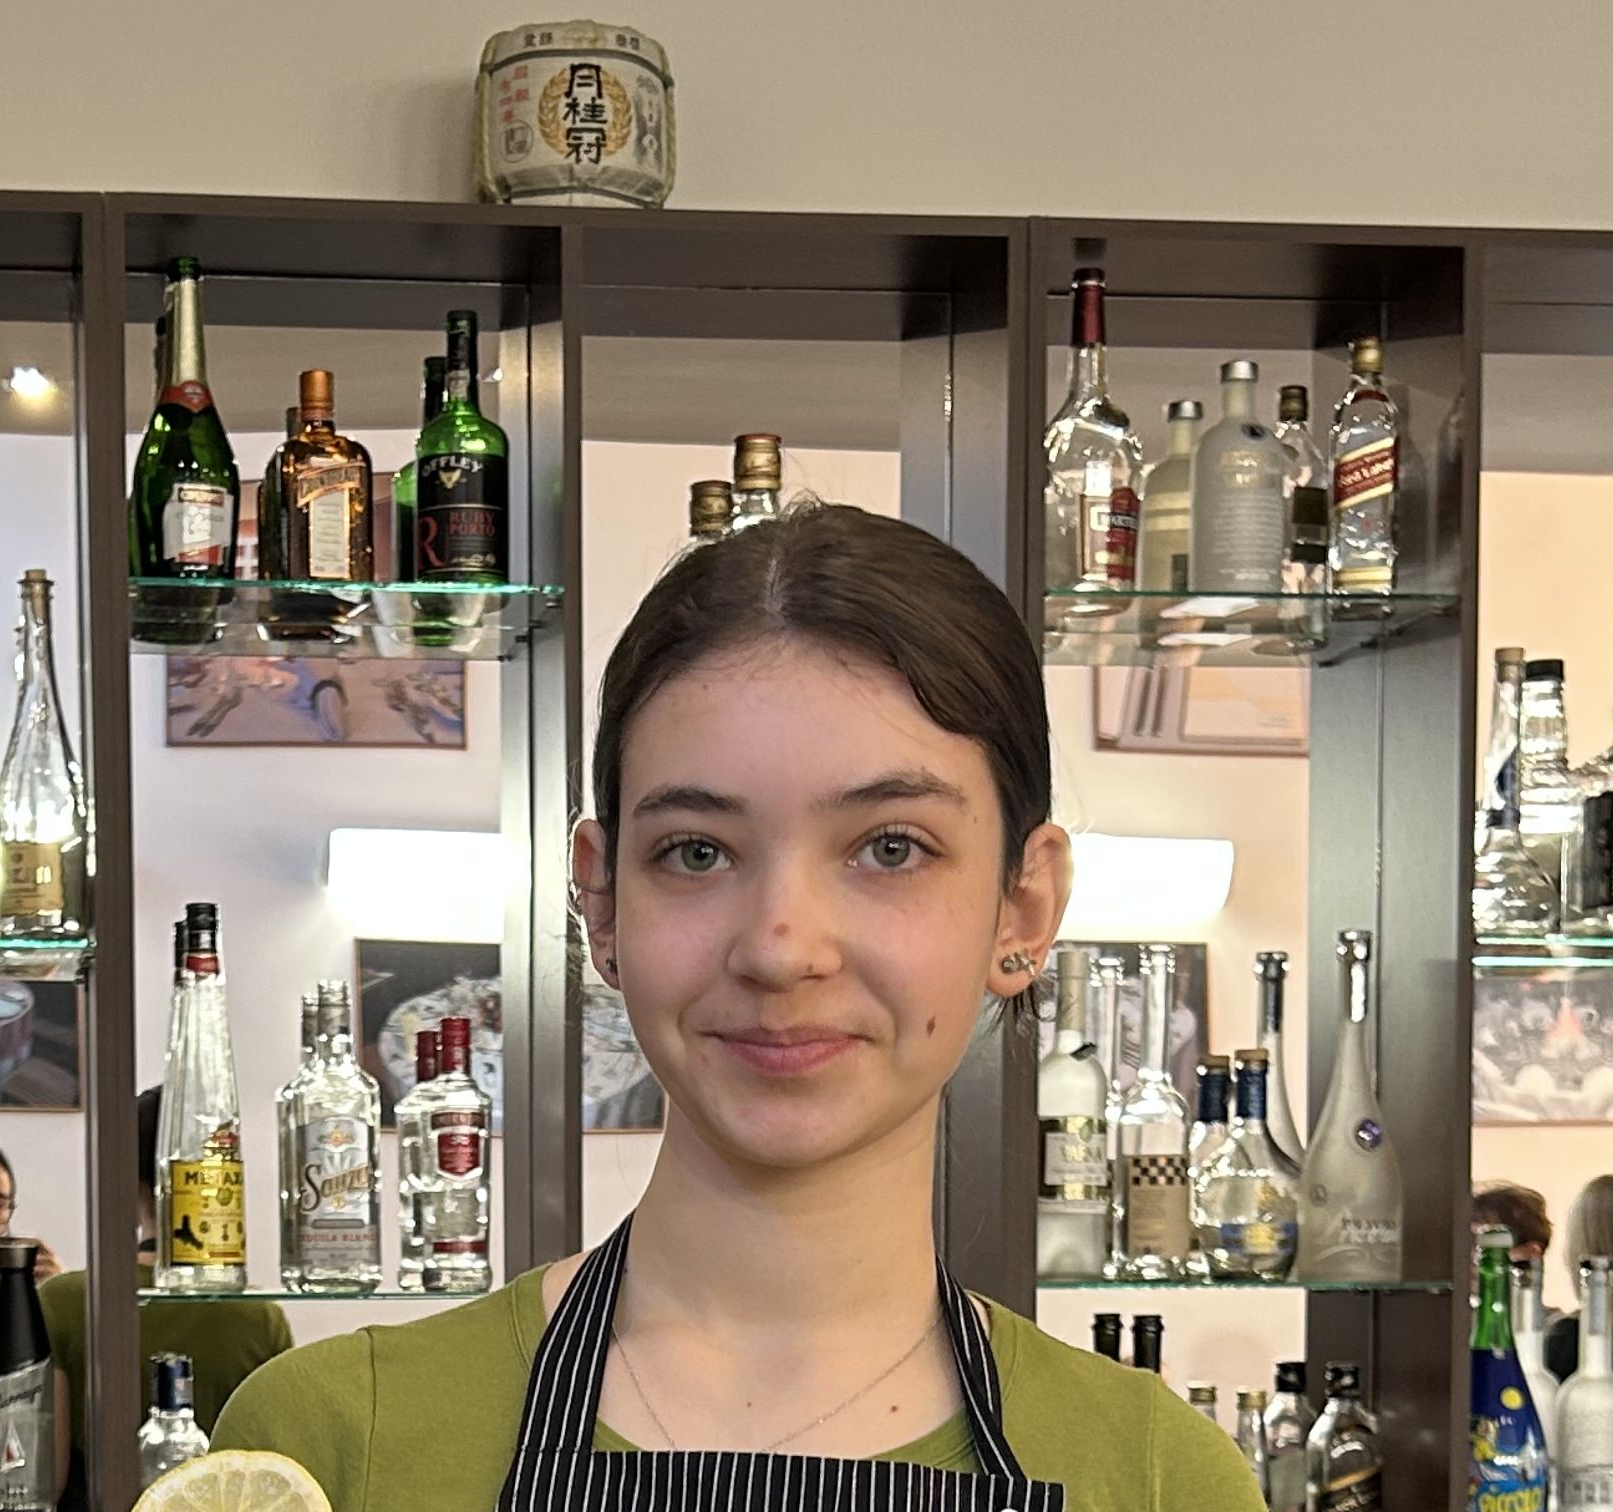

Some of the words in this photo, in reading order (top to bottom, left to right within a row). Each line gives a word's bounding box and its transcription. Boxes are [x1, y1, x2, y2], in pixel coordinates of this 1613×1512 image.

[563, 63, 607, 165] 月桂冠
[421, 457, 482, 477] OFFLEY
